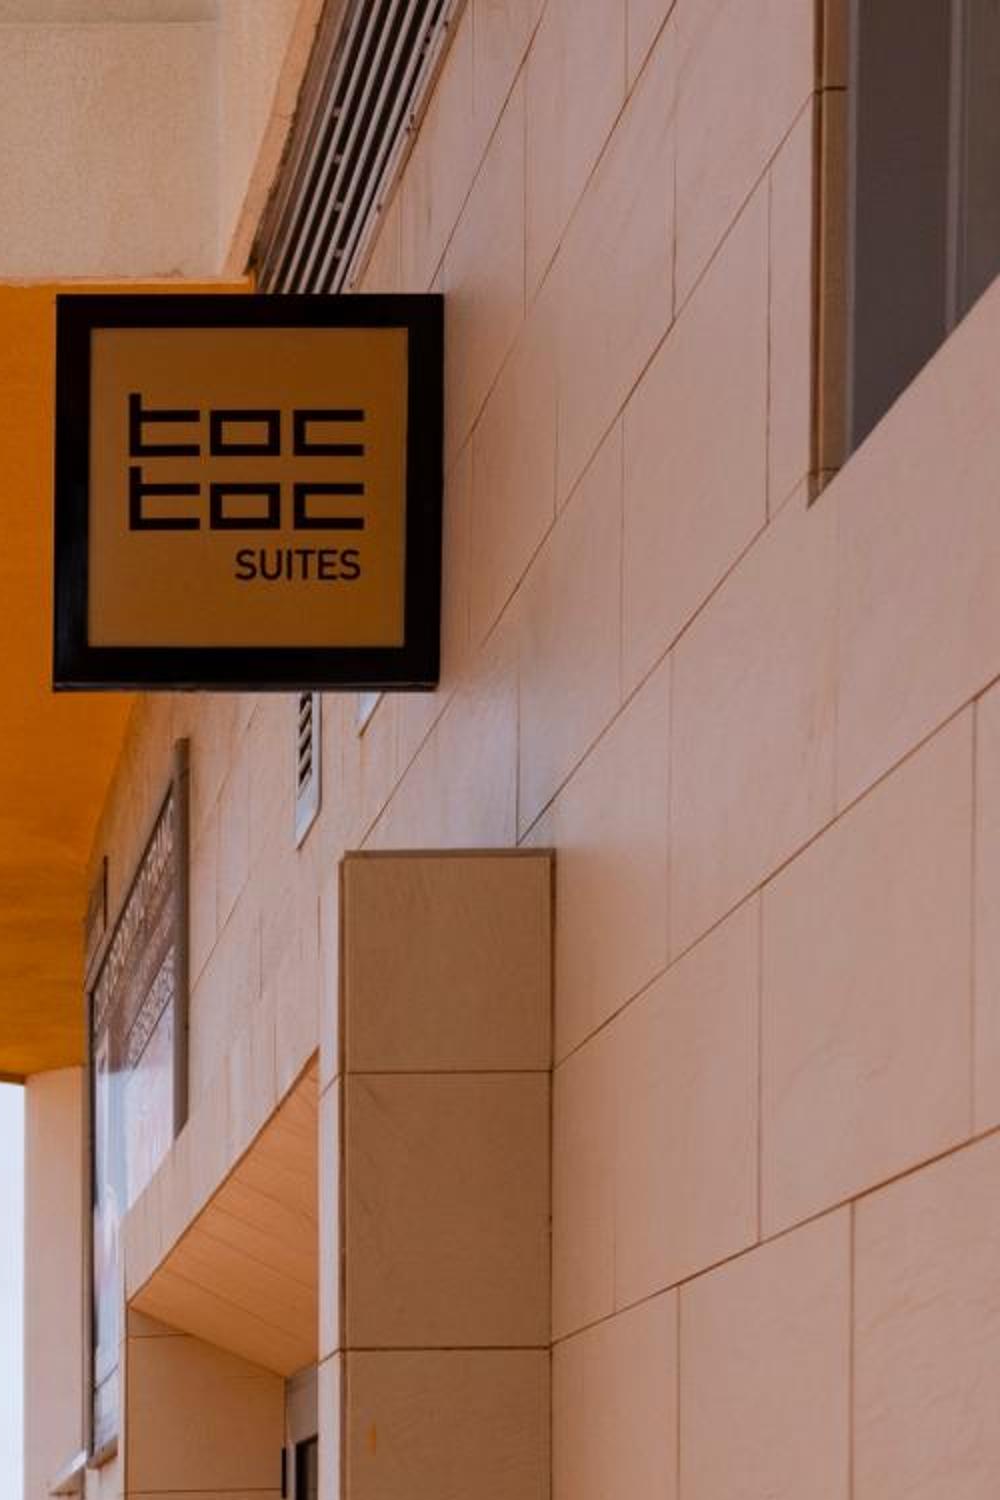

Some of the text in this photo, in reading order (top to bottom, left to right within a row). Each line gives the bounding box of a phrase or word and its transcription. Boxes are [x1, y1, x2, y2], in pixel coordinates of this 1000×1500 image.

[129, 392, 365, 457] toc
[129, 466, 365, 531] toc
[234, 549, 362, 581] SUITES
